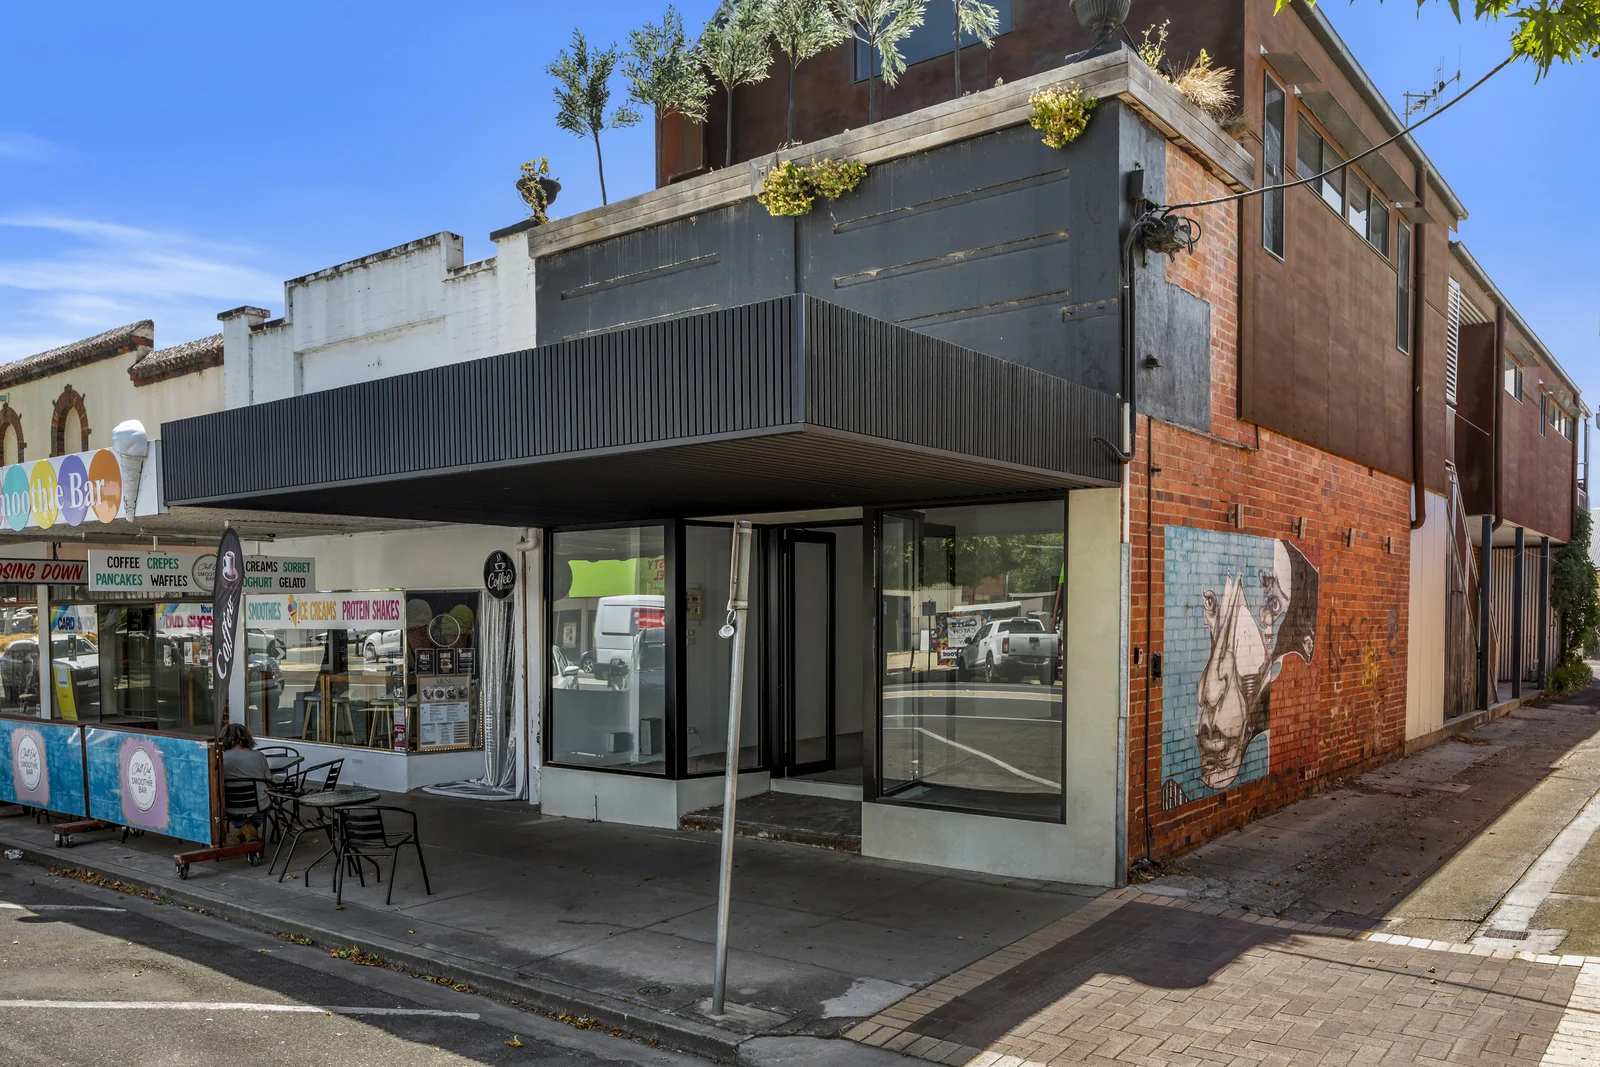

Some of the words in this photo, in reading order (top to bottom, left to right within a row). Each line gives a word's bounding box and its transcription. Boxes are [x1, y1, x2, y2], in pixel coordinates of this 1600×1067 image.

[68, 472, 105, 509] Bar
[107, 556, 140, 569] COFFEE
[146, 557, 179, 570] CREPES
[245, 560, 278, 573] CREAMS
[282, 561, 311, 574] SORBET
[41, 563, 83, 580] DOWN
[95, 573, 143, 586] PANCAKES
[150, 574, 188, 587] WAFFLES
[279, 577, 306, 589] GELATO
[488, 569, 513, 591] Coffee
[248, 602, 281, 621] SMOOTHIES
[298, 601, 308, 620] ICE
[310, 600, 337, 621] CREAMS
[342, 600, 370, 620] PROTEIN
[372, 600, 400, 621] SHAKES
[58, 616, 75, 630] CARD
[166, 615, 184, 629] DVD
[216, 595, 234, 680] Coffee
[20, 760, 39, 770] SMOOTHIE
[131, 777, 154, 787] SMOOTHIE
[138, 786, 147, 794] BAR
